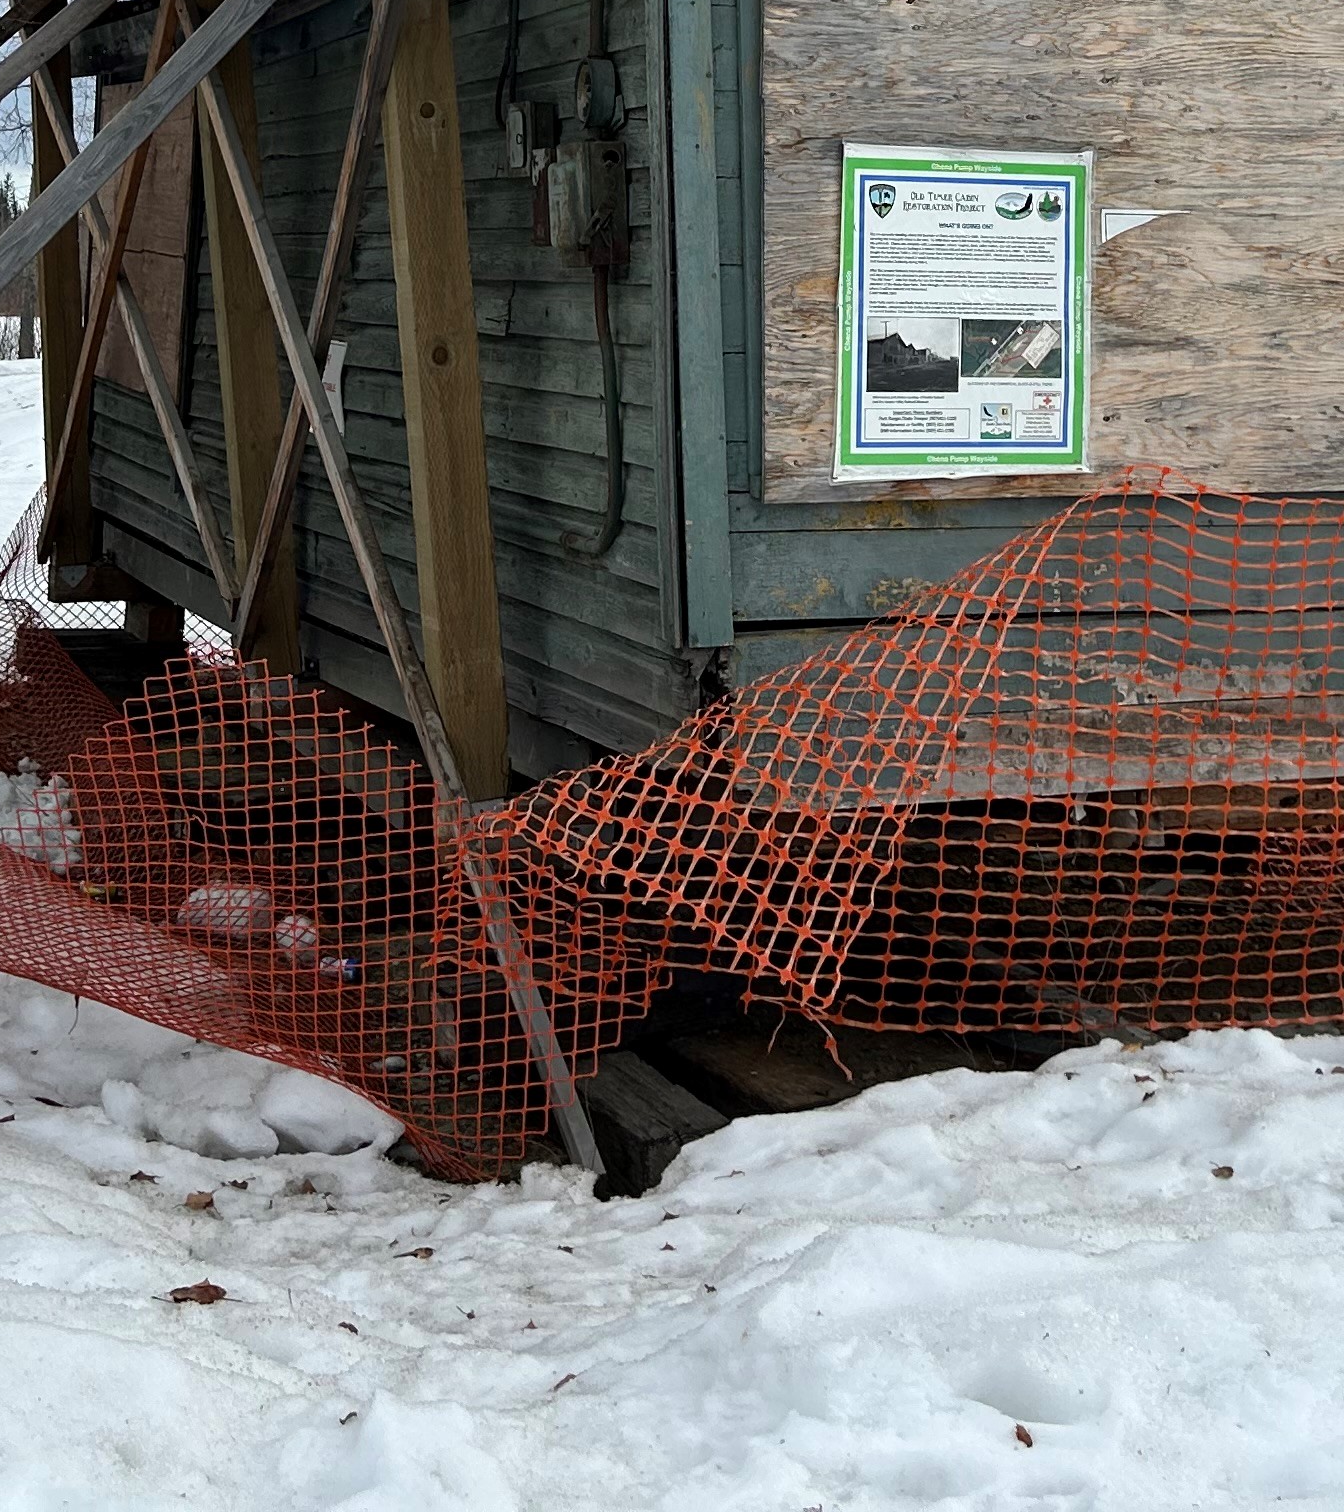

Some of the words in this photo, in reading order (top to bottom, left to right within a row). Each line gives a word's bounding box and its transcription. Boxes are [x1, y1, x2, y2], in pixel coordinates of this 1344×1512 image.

[954, 163, 974, 172] Pump
[974, 164, 1002, 173] Wayside
[910, 191, 925, 201] OLD
[903, 201, 953, 212] RESTORATION
[956, 203, 986, 212] PROJECT
[949, 455, 970, 464] Pump
[970, 455, 998, 464] Wayside
